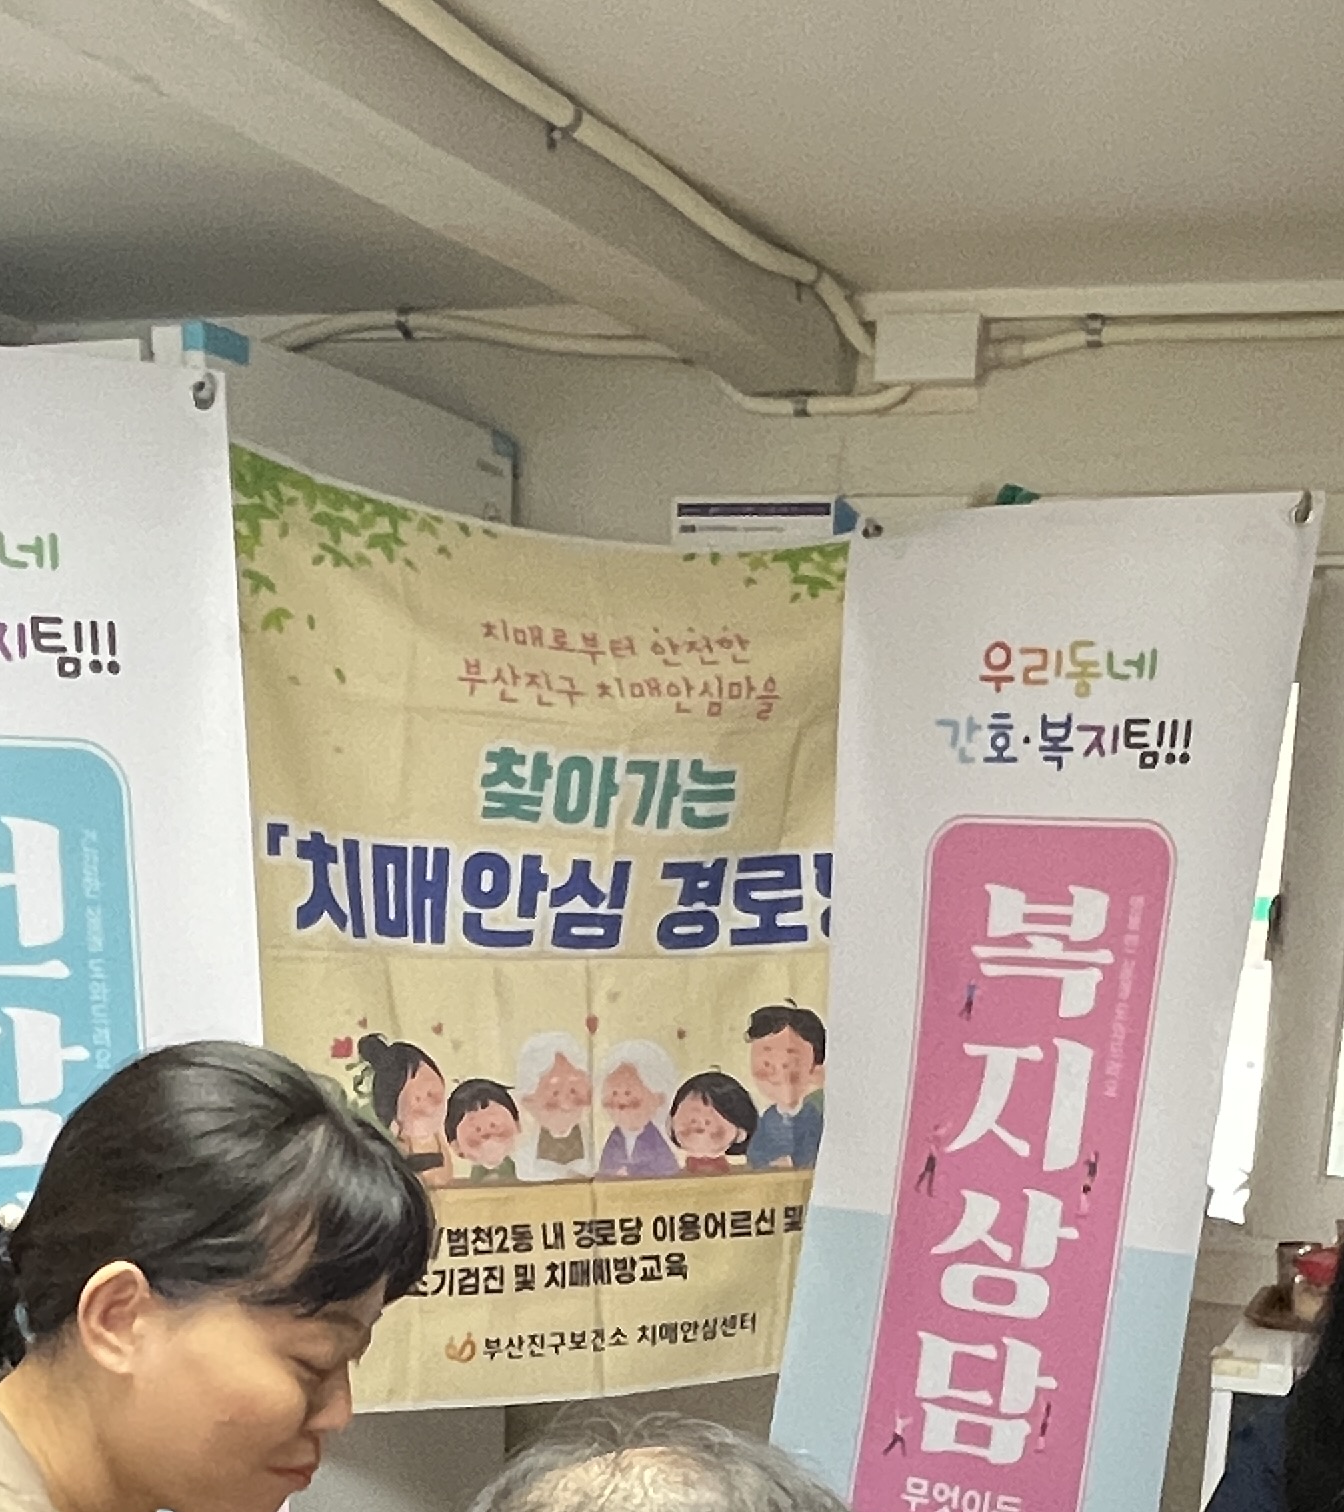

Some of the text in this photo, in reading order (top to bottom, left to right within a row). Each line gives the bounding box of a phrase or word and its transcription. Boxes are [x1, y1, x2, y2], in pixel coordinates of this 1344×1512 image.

[481, 619, 751, 668] 치매로부터 안전한
[978, 640, 1159, 698] 우리동네
[457, 657, 782, 722] 부산진구 치매안심마을
[935, 712, 1194, 772] 간호·복지팀!!!
[481, 746, 737, 829] 찾아가는
[914, 882, 1116, 1466] 복지상담
[541, 1220, 566, 1251] 내
[572, 1216, 644, 1250] 경로당
[652, 1206, 777, 1244] 이용어르신
[783, 1203, 804, 1234] 및
[514, 1262, 536, 1293] 및
[544, 1251, 689, 1291] 치매예방교육
[482, 1311, 757, 1361] 부산진구보건소 치매안심센터
